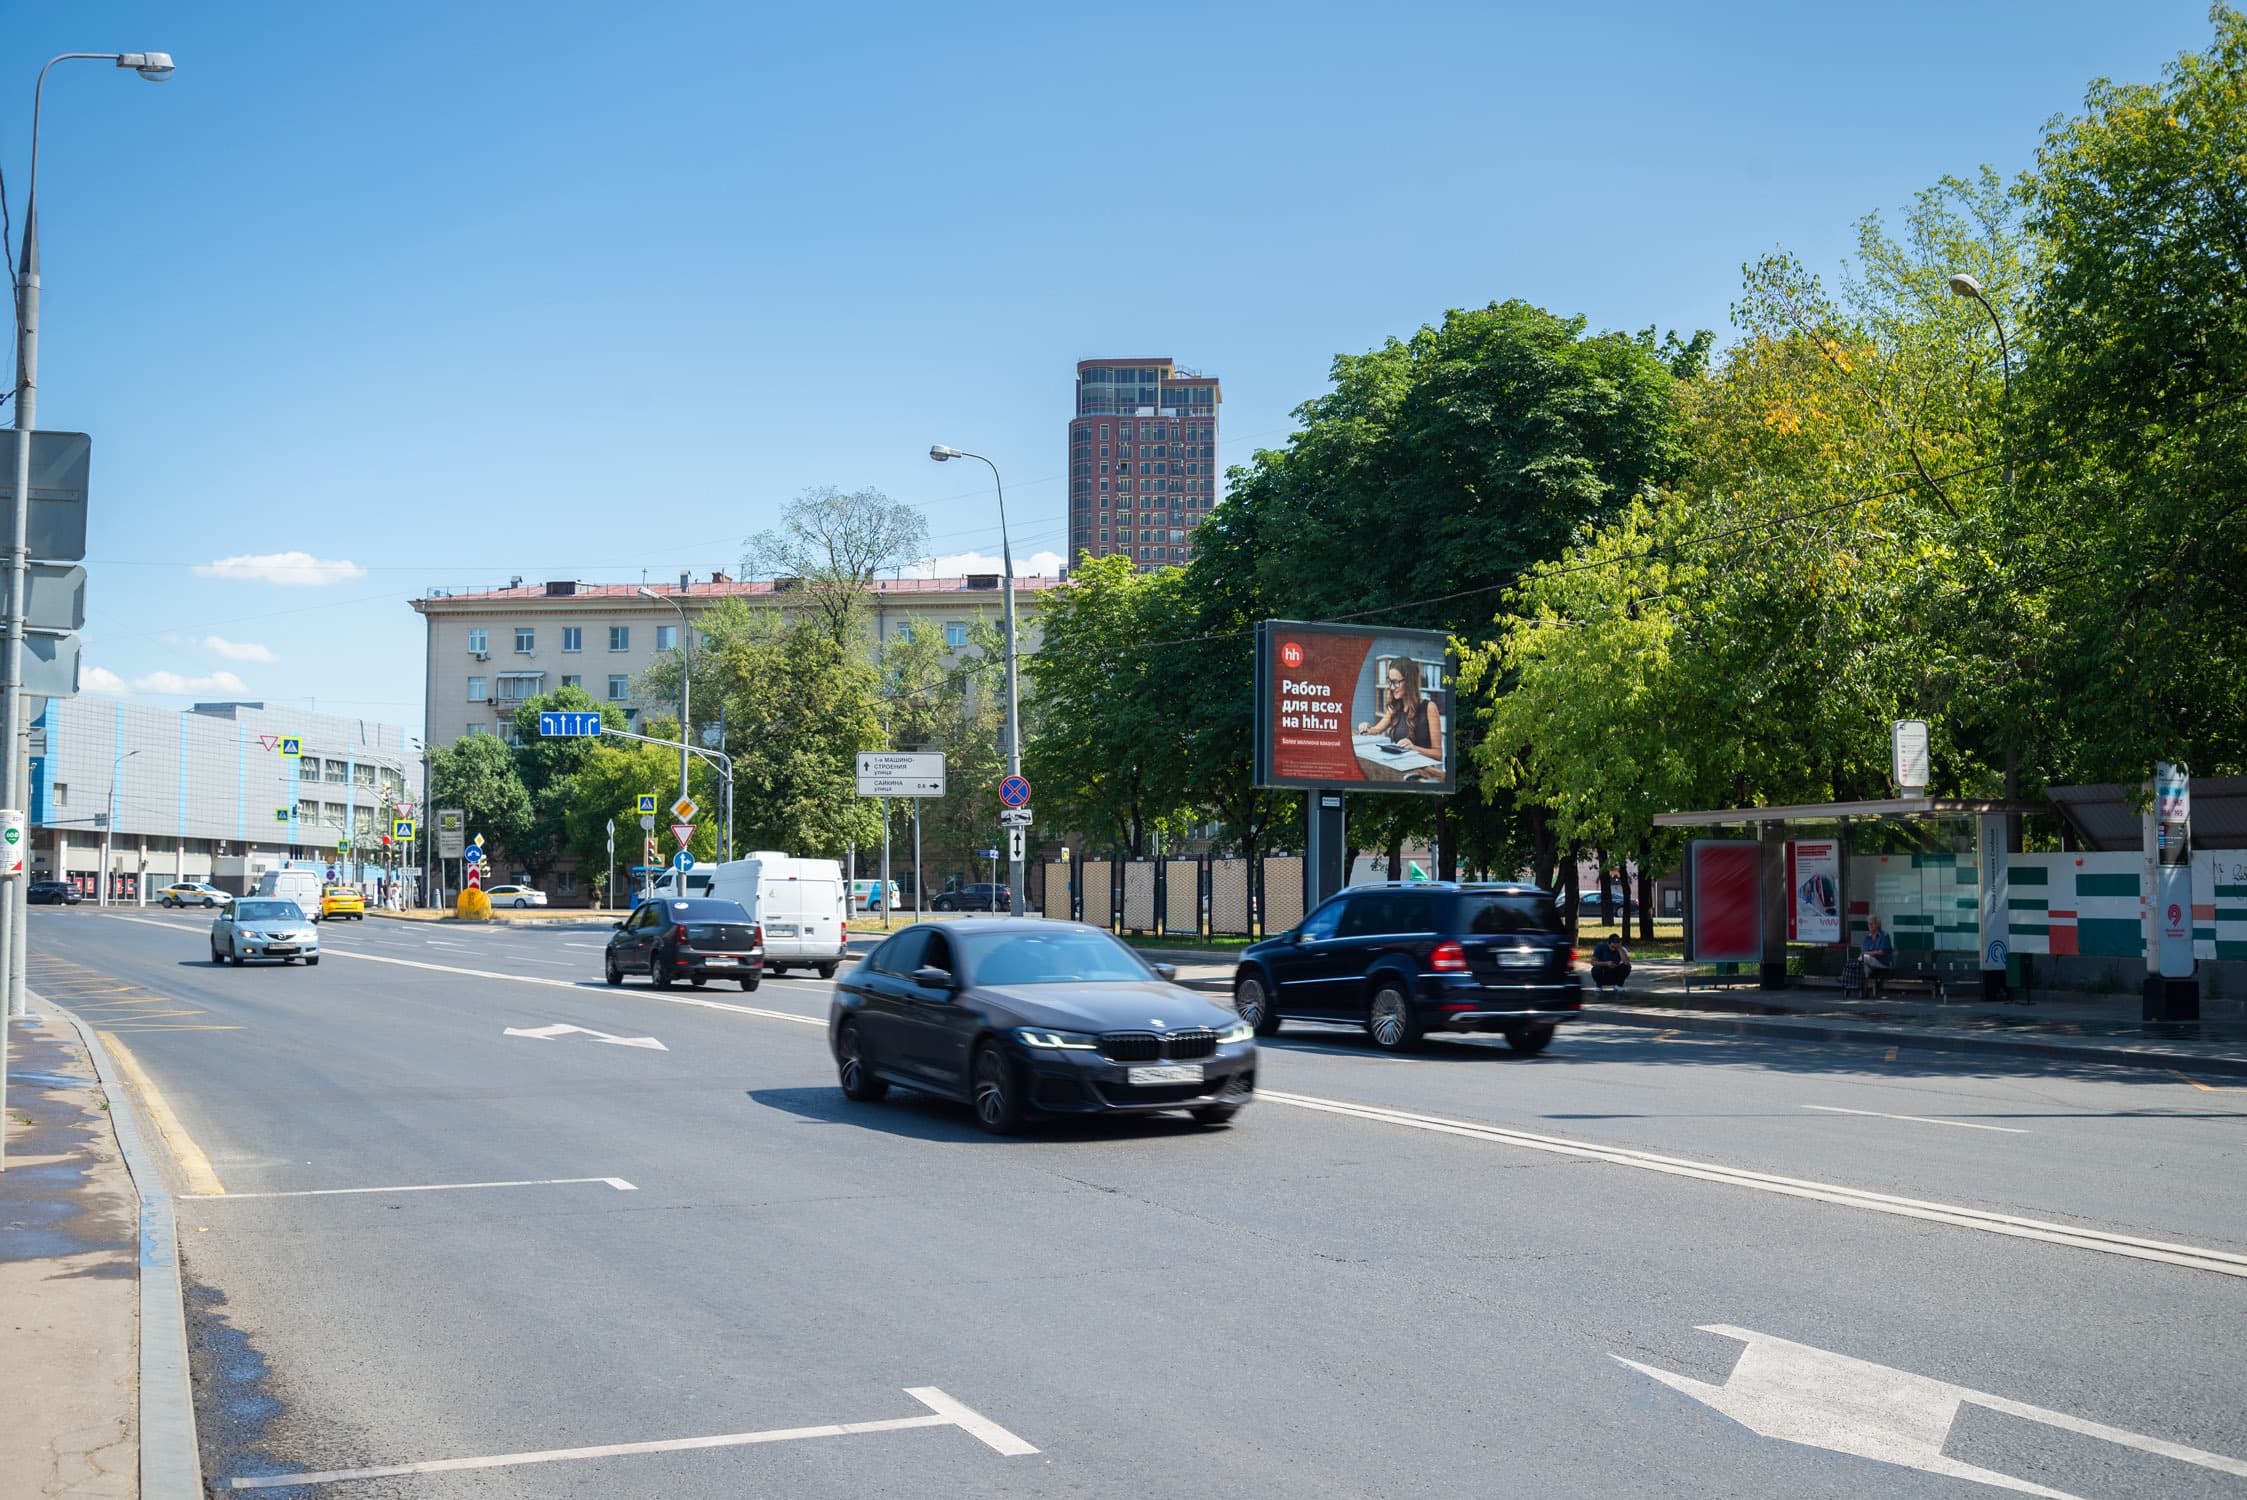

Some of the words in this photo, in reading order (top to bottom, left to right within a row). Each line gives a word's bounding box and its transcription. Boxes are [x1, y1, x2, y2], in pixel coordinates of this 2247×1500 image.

[1285, 647, 1300, 661] hh
[1282, 679, 1331, 697] Работа
[1282, 700, 1309, 713] для
[1311, 701, 1343, 714] всех
[1282, 716, 1299, 728] на
[1302, 714, 1338, 731] hh.ru
